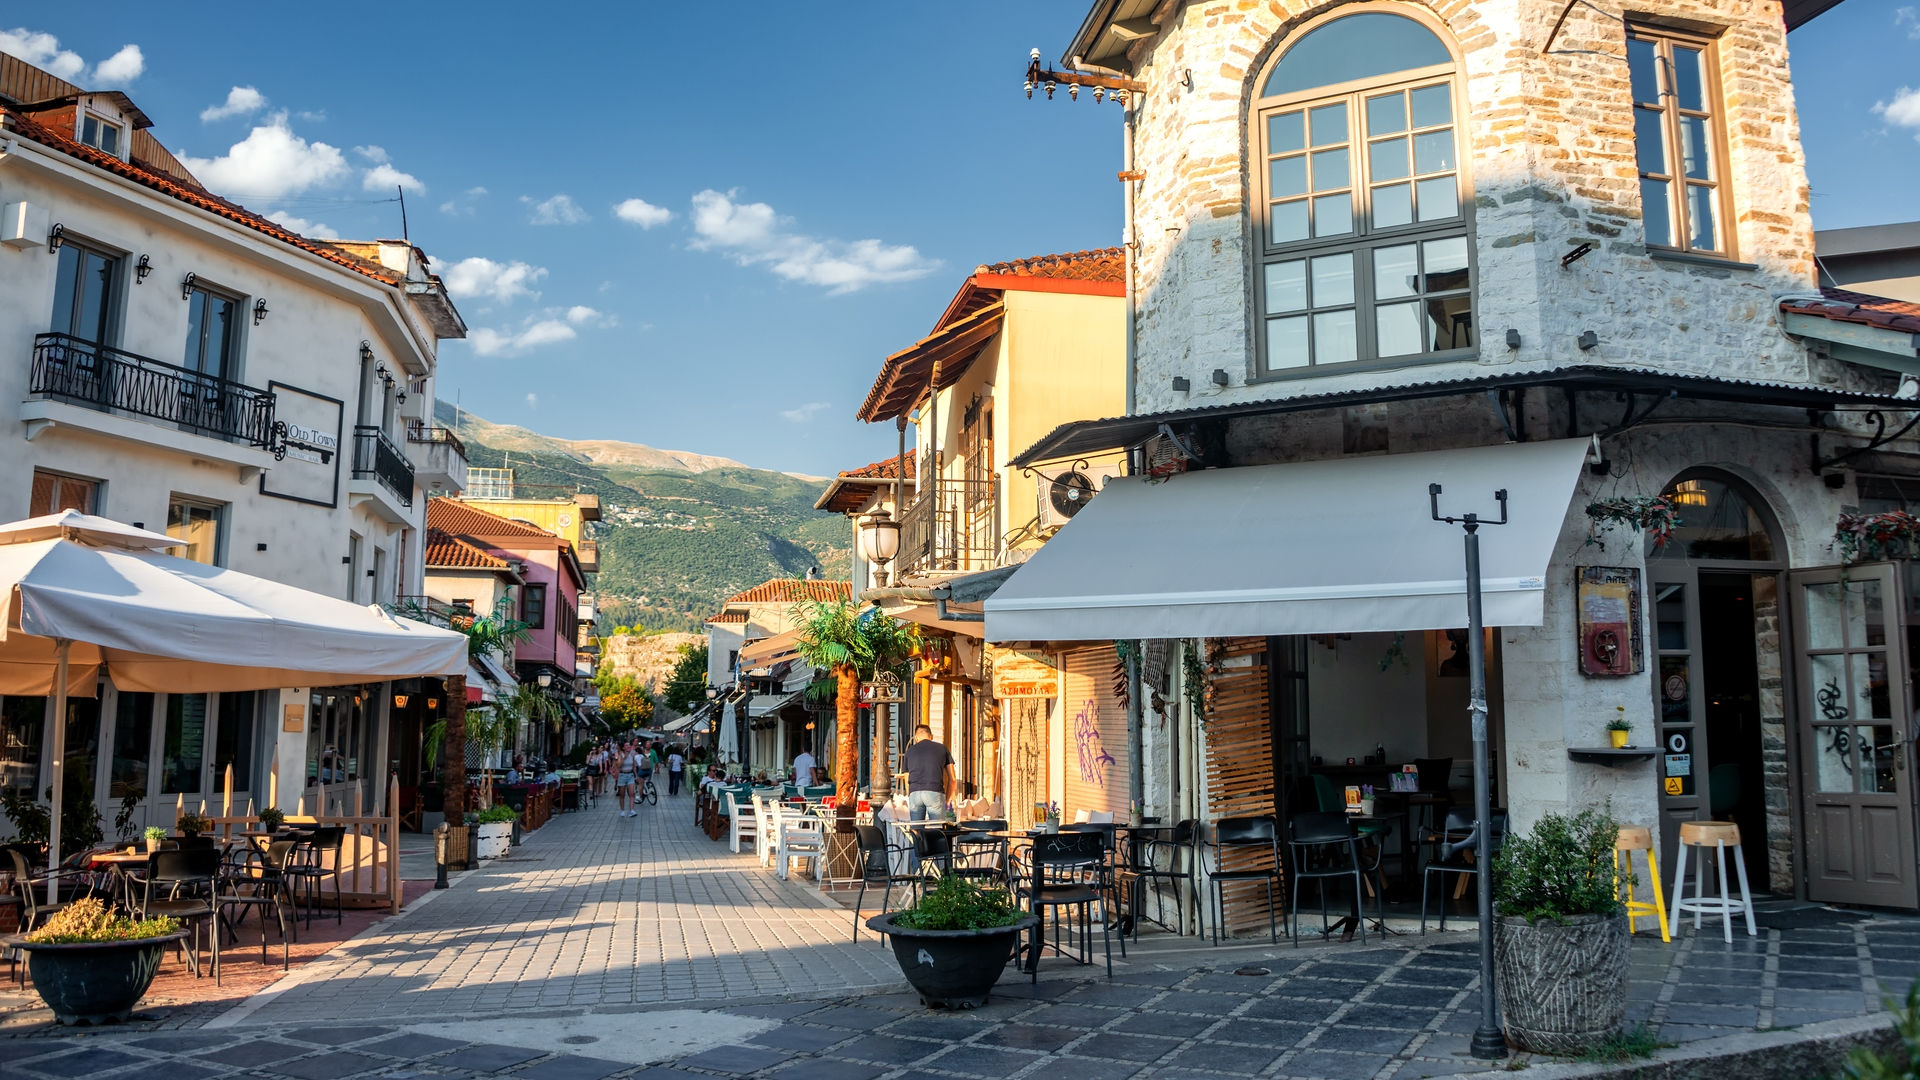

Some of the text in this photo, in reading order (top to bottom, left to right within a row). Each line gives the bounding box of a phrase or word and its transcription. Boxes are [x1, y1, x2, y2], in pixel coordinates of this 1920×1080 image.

[290, 425, 336, 447] OLD TOWN
[1605, 575, 1626, 584] ARTE
